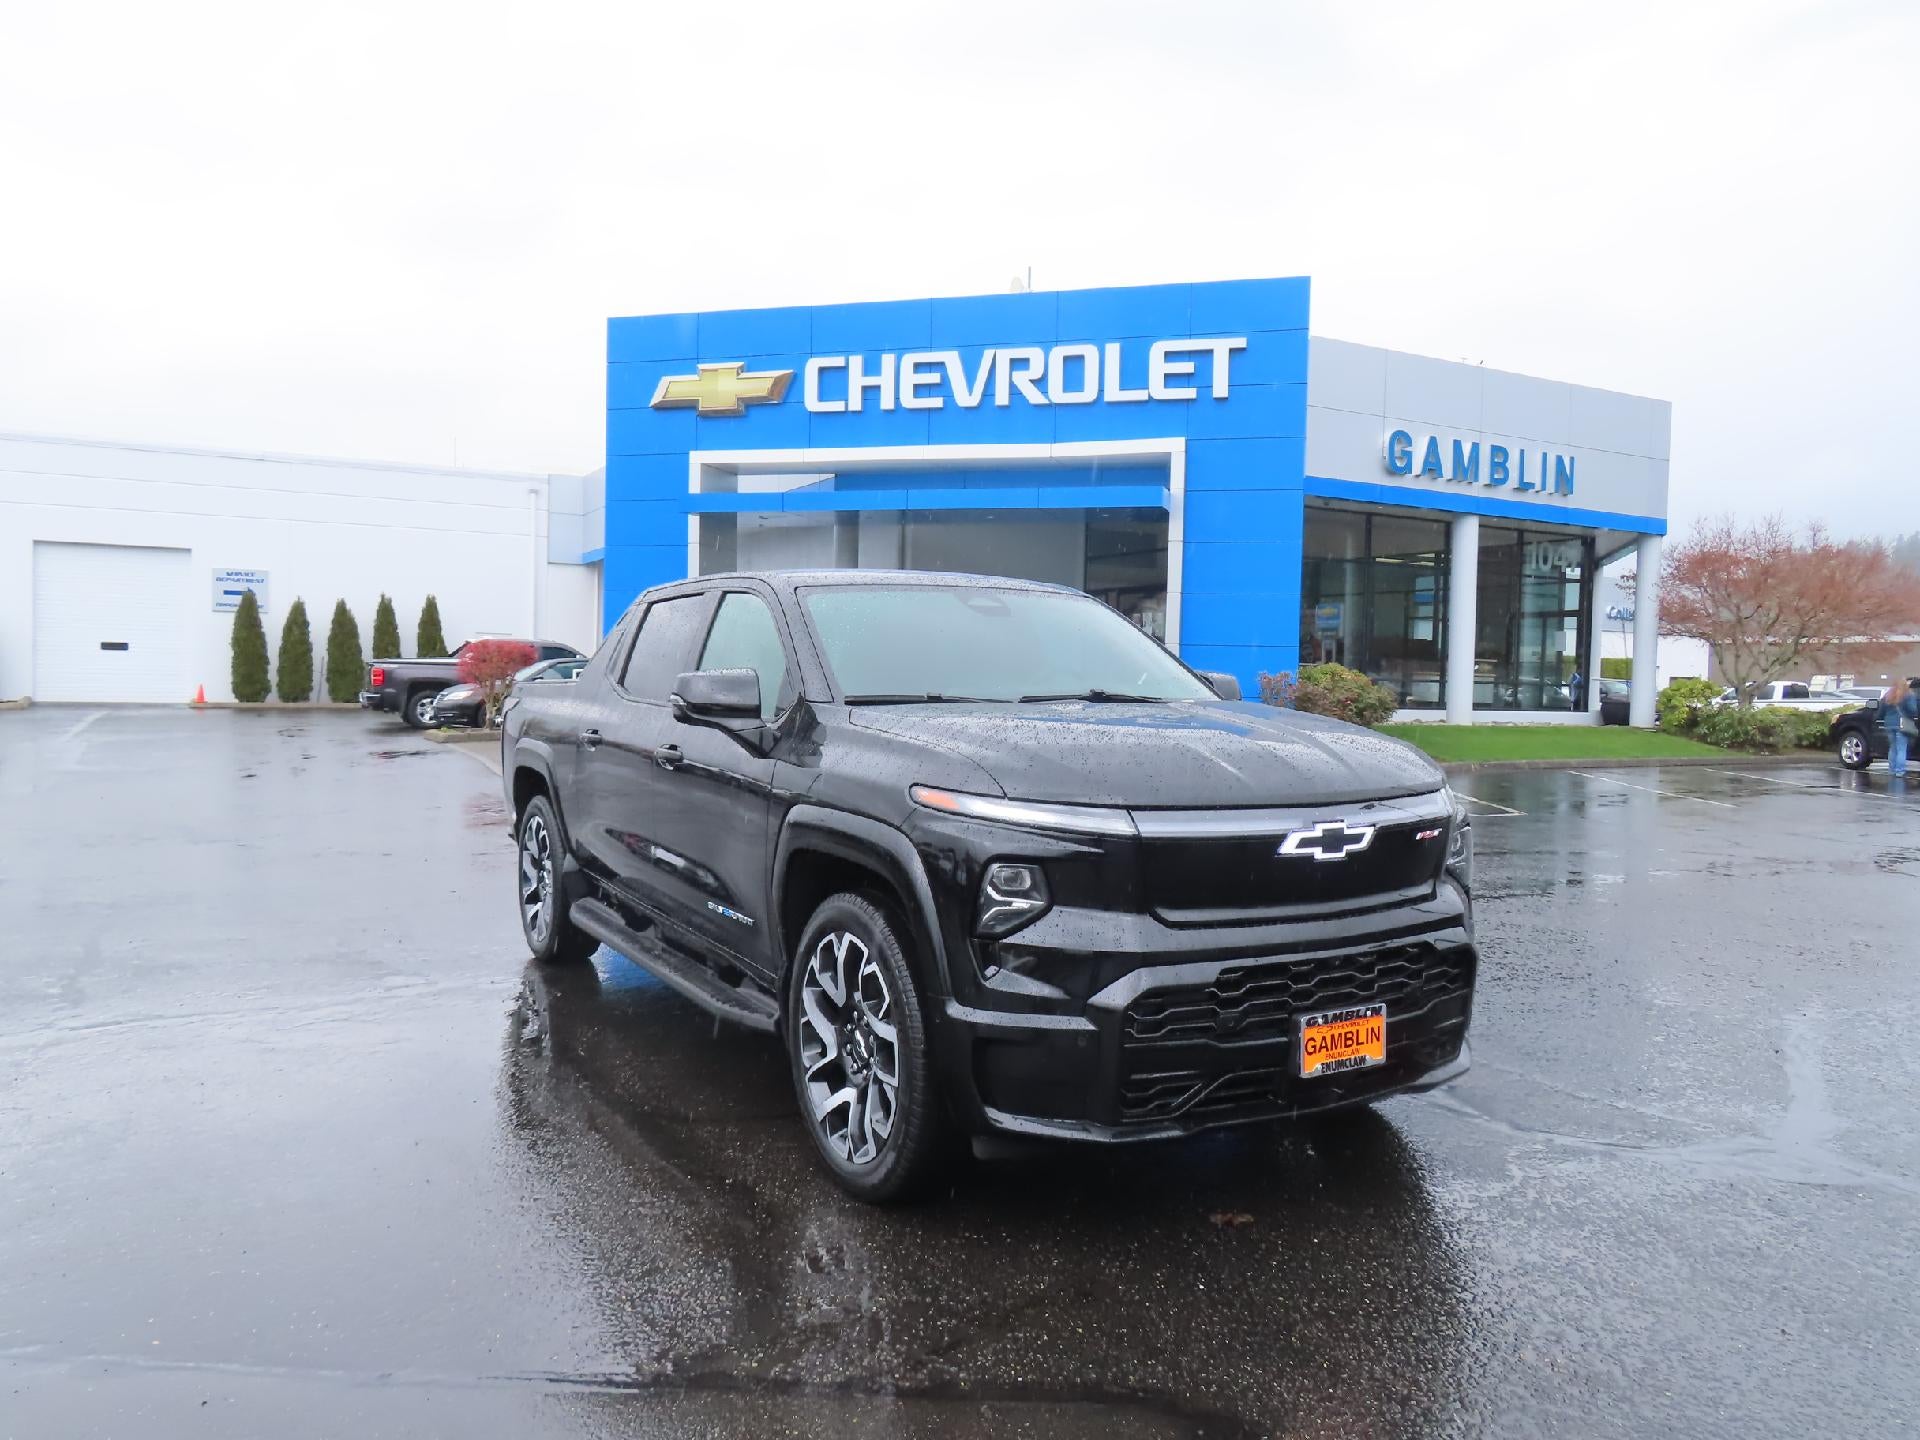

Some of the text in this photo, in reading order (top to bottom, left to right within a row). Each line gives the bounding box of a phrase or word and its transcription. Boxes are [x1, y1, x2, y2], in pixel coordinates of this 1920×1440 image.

[804, 337, 1247, 412] CHEVROLET
[1388, 429, 1575, 495] GAMBLIN
[1306, 1005, 1383, 1027] GAMBLIN
[1305, 1026, 1381, 1056] GAMBLIN
[1321, 1055, 1367, 1073] ENUMCLAW
